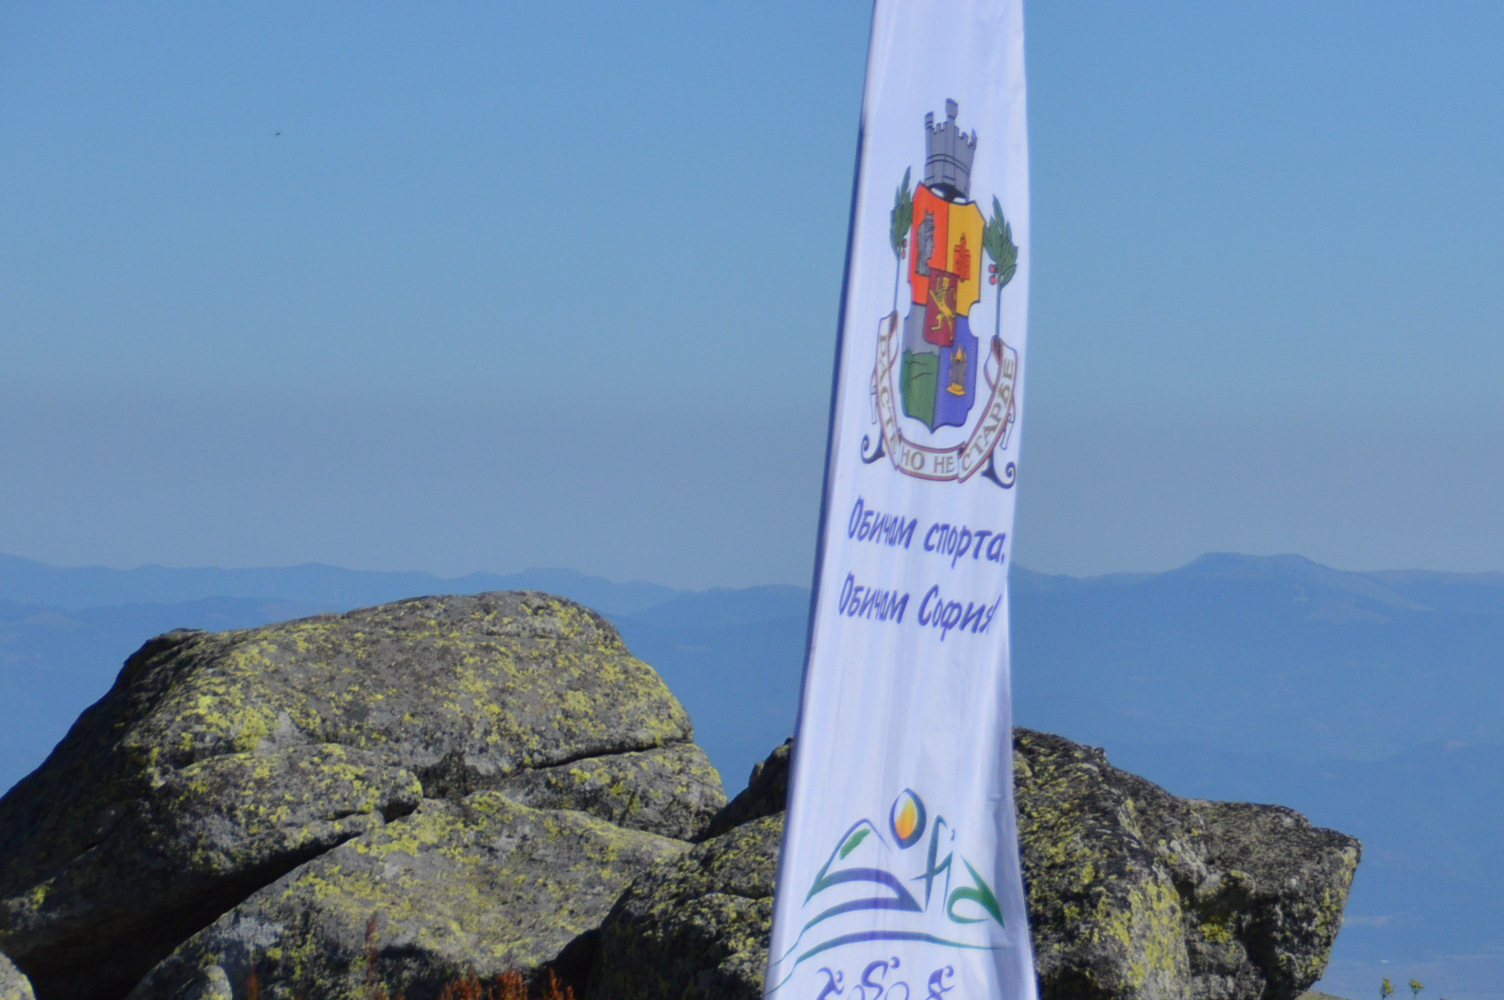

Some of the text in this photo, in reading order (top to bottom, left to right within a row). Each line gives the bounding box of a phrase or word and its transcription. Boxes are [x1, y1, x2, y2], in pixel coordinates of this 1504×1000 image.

[900, 446, 925, 470] НО
[933, 456, 955, 474] НЕ
[848, 495, 918, 549] Обичам
[839, 571, 910, 624] Обичам
